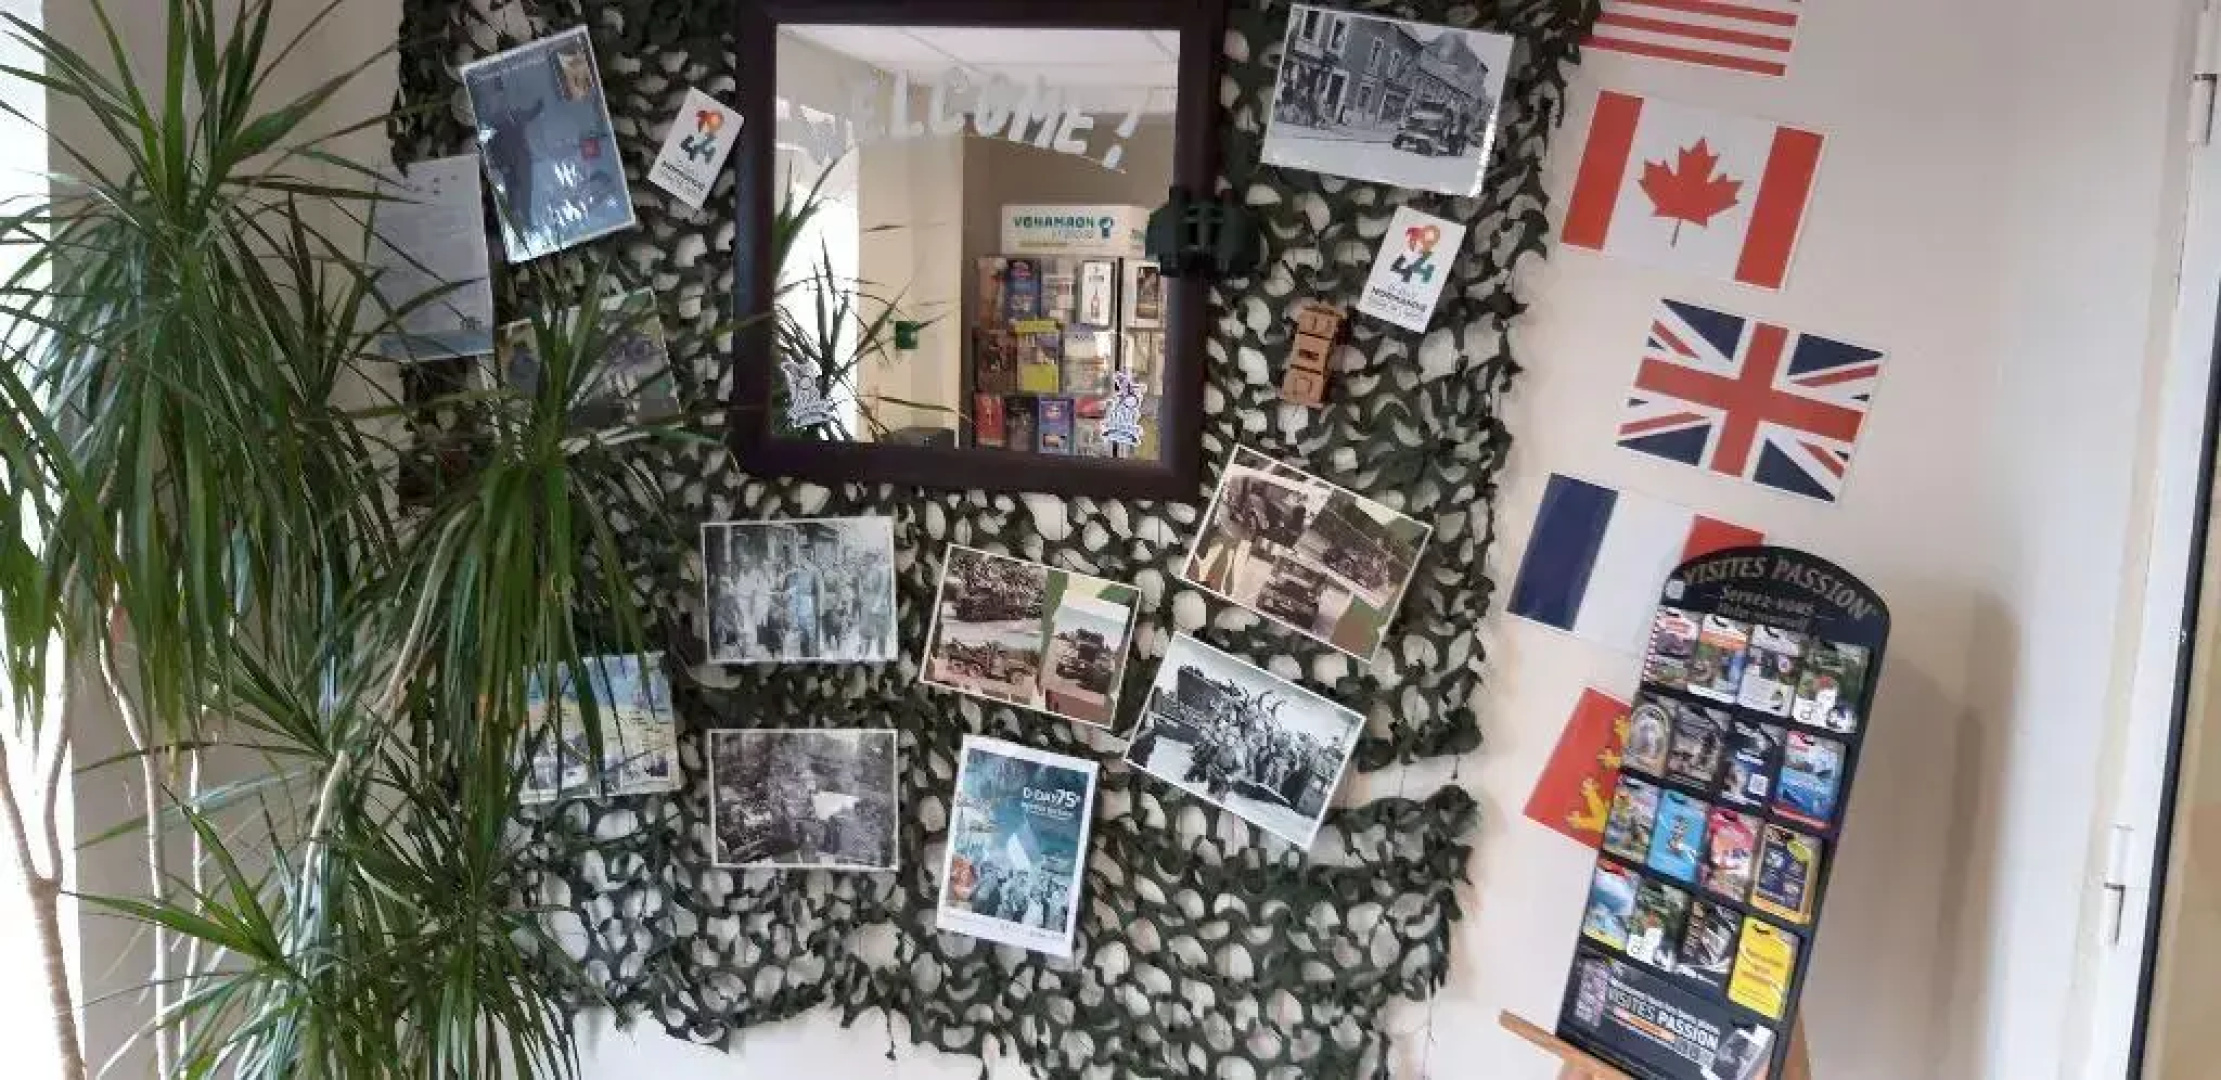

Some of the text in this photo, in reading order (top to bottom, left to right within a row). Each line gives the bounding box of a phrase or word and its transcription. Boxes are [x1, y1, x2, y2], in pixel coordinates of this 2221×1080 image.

[681, 134, 717, 164] 44
[1390, 254, 1435, 284] 44
[1771, 556, 1873, 621] PASSION
